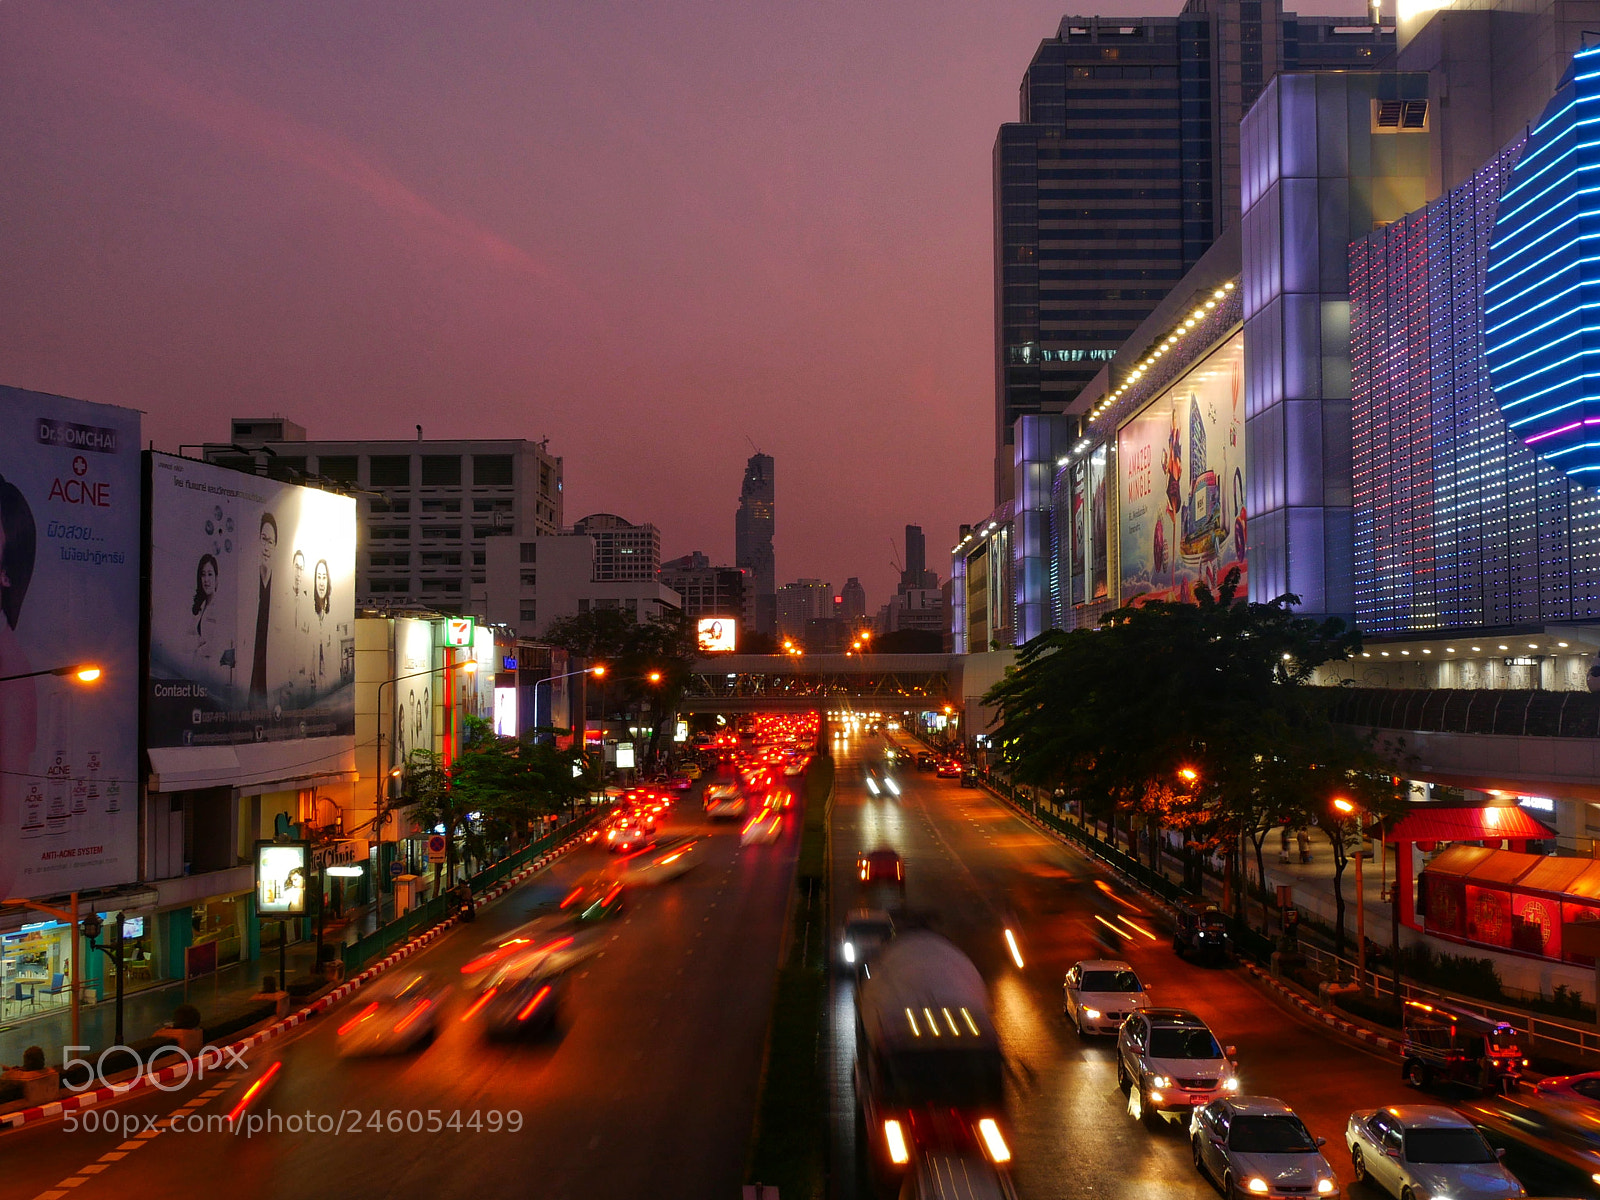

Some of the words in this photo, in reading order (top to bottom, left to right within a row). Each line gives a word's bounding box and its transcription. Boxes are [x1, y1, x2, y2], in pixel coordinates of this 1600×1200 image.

[1128, 444, 1152, 479] AMAZED
[48, 478, 110, 507] ACNE
[1128, 470, 1152, 504] MINGLE
[154, 683, 191, 699] Contact
[192, 684, 208, 698] Us:
[47, 765, 70, 775] ACNE
[41, 848, 76, 861] ANTI-ACNE
[77, 845, 104, 857] SYSTEM
